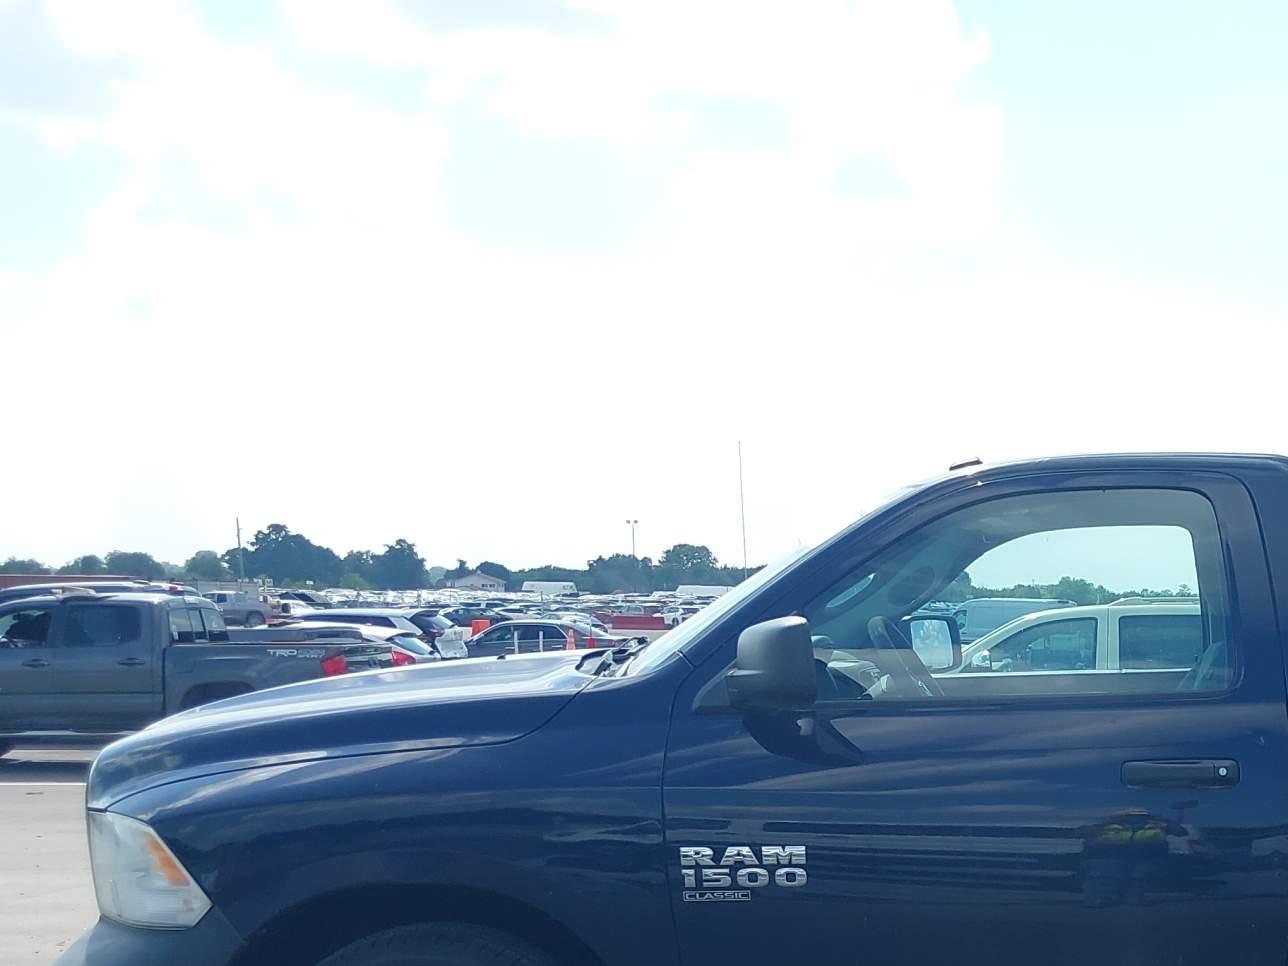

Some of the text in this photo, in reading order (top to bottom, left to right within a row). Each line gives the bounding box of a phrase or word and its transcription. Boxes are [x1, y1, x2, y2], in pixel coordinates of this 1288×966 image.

[679, 845, 807, 866] RAM
[681, 867, 808, 888] 1500
[685, 892, 749, 900] CLASSIC
